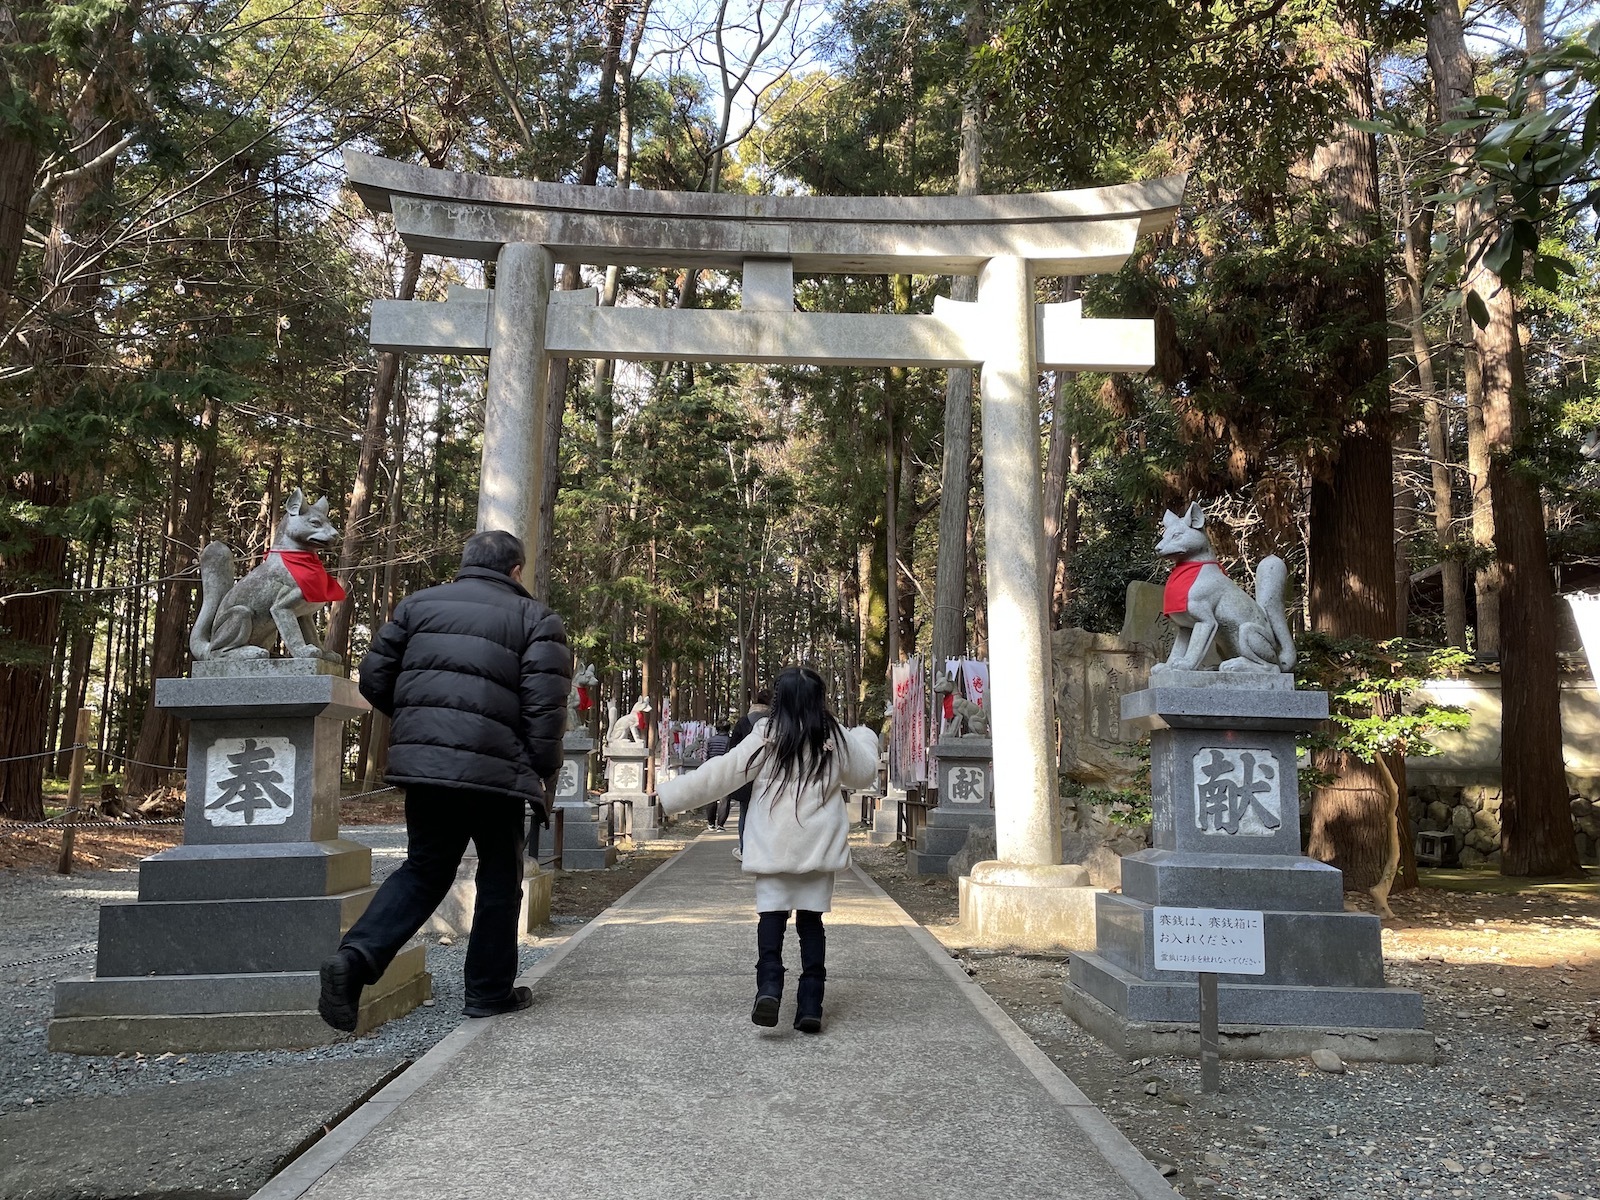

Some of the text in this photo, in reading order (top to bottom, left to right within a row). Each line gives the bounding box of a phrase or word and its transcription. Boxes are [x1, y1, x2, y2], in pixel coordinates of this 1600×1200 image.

[205, 739, 293, 825] 奉
[952, 767, 983, 800] 献
[1198, 749, 1281, 835] 献
[1160, 914, 1259, 930] 賽銭は、賽銭箱に
[1160, 932, 1243, 946] お入れください
